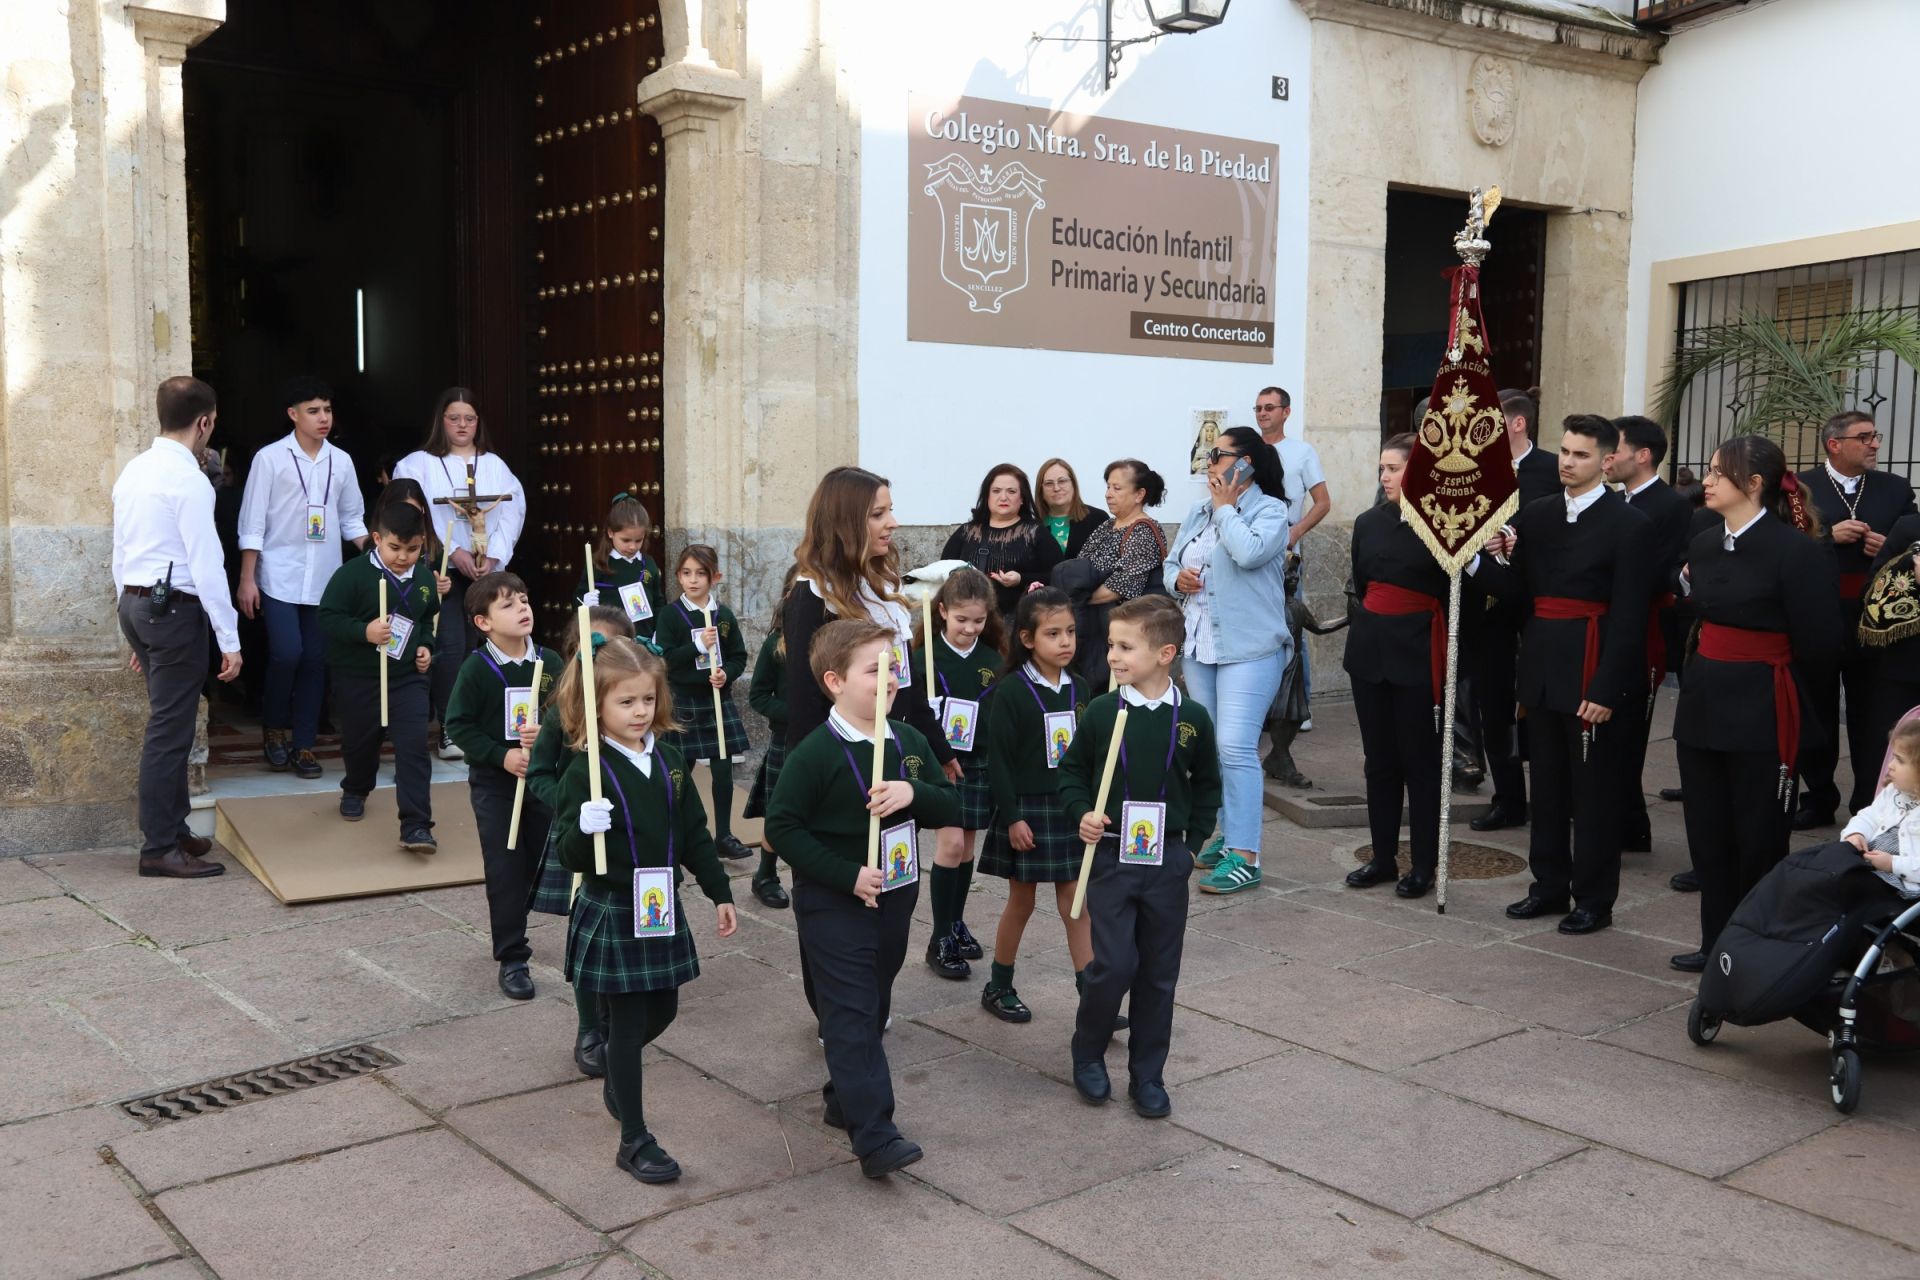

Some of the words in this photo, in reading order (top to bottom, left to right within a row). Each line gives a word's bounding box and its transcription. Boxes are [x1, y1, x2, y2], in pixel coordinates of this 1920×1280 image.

[1277, 78, 1286, 97] 3
[925, 112, 1020, 154] Colegio
[1027, 123, 1087, 159] Ntra.
[1094, 133, 1137, 166] Sra.
[1144, 140, 1170, 170] de
[1175, 144, 1195, 173] la
[1200, 149, 1271, 183] Piedad
[1052, 216, 1158, 255] Educación
[1164, 229, 1233, 262] Infantil
[967, 284, 1003, 292] SENCILLEZ
[1051, 259, 1138, 294] Primaria
[1143, 274, 1155, 302] y
[1160, 270, 1266, 305] Secundaria
[1144, 319, 1189, 337] Centro
[1191, 323, 1266, 343] Concertado
[1430, 469, 1440, 481] DE
[1444, 470, 1482, 486] ESPINAS
[1435, 485, 1476, 496] CÓRDOBA
